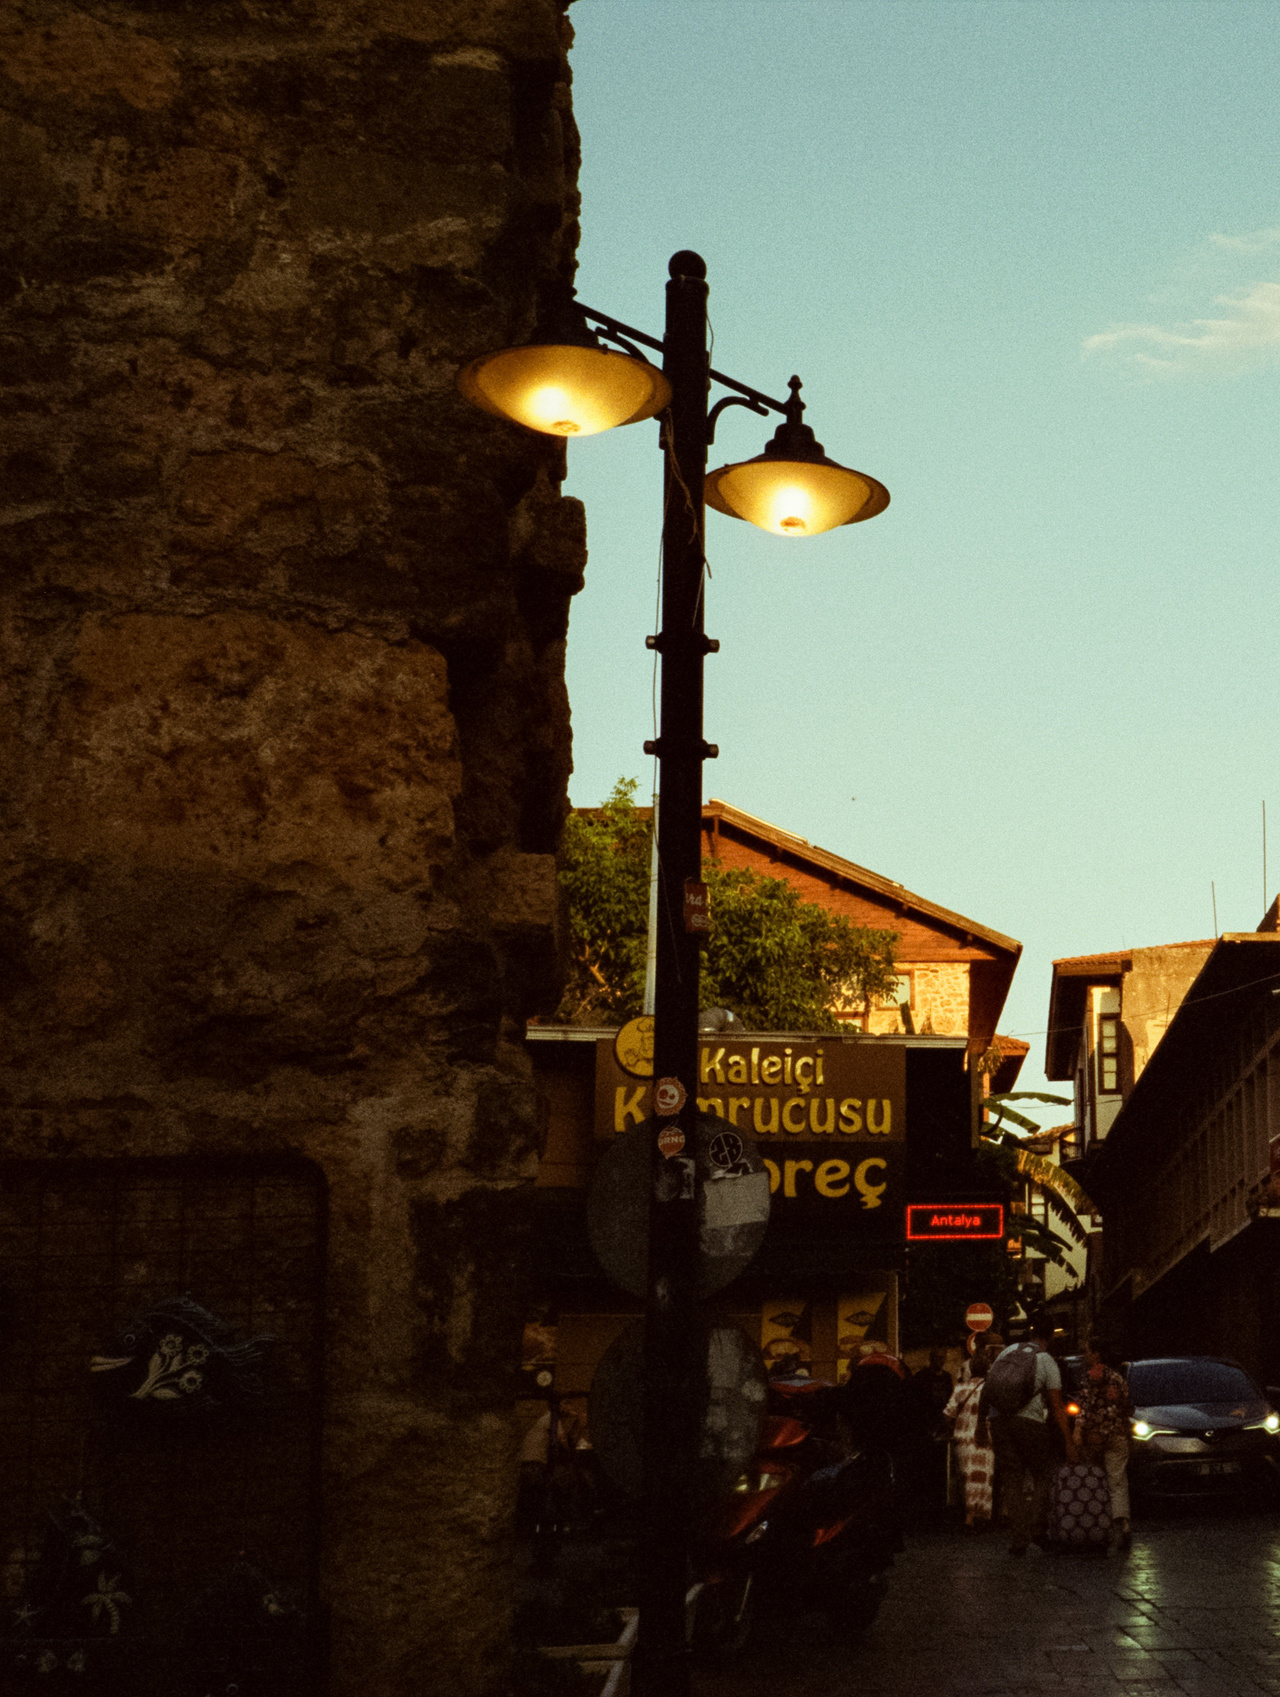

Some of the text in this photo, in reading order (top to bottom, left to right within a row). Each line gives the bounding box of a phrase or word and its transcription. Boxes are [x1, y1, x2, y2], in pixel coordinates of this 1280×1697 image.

[700, 1047, 825, 1094] Kaleiçi
[613, 1086, 893, 1136] Krucusu
[929, 1213, 982, 1229] Antalya
